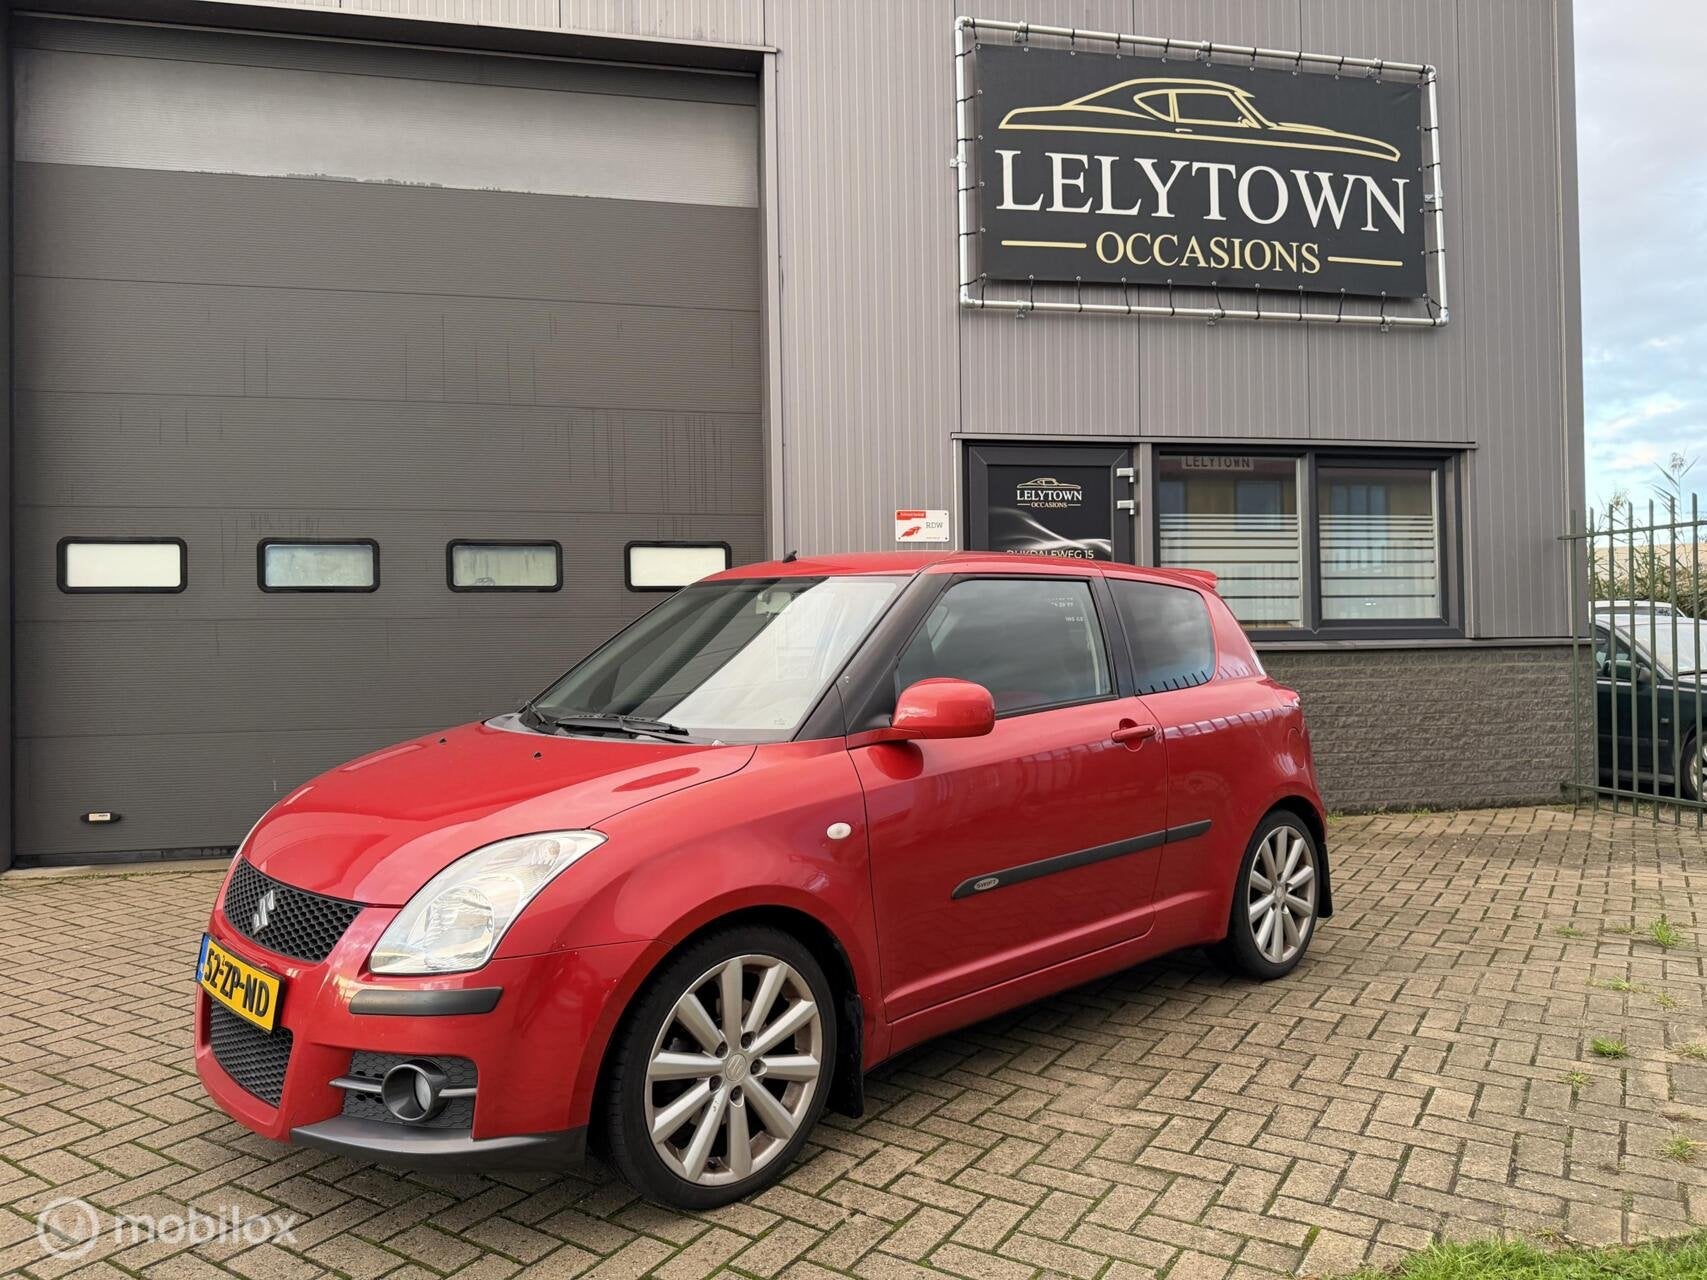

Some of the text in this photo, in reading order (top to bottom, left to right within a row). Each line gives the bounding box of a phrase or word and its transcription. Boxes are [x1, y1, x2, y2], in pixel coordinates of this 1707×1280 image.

[995, 149, 1410, 234] LELYTOWN
[1095, 231, 1321, 274] OCCASIONS
[1016, 490, 1082, 501] LELYTOWN
[925, 521, 943, 529] RDW
[1085, 550, 1094, 559] 15
[204, 947, 270, 1017] 52-ZP-ND
